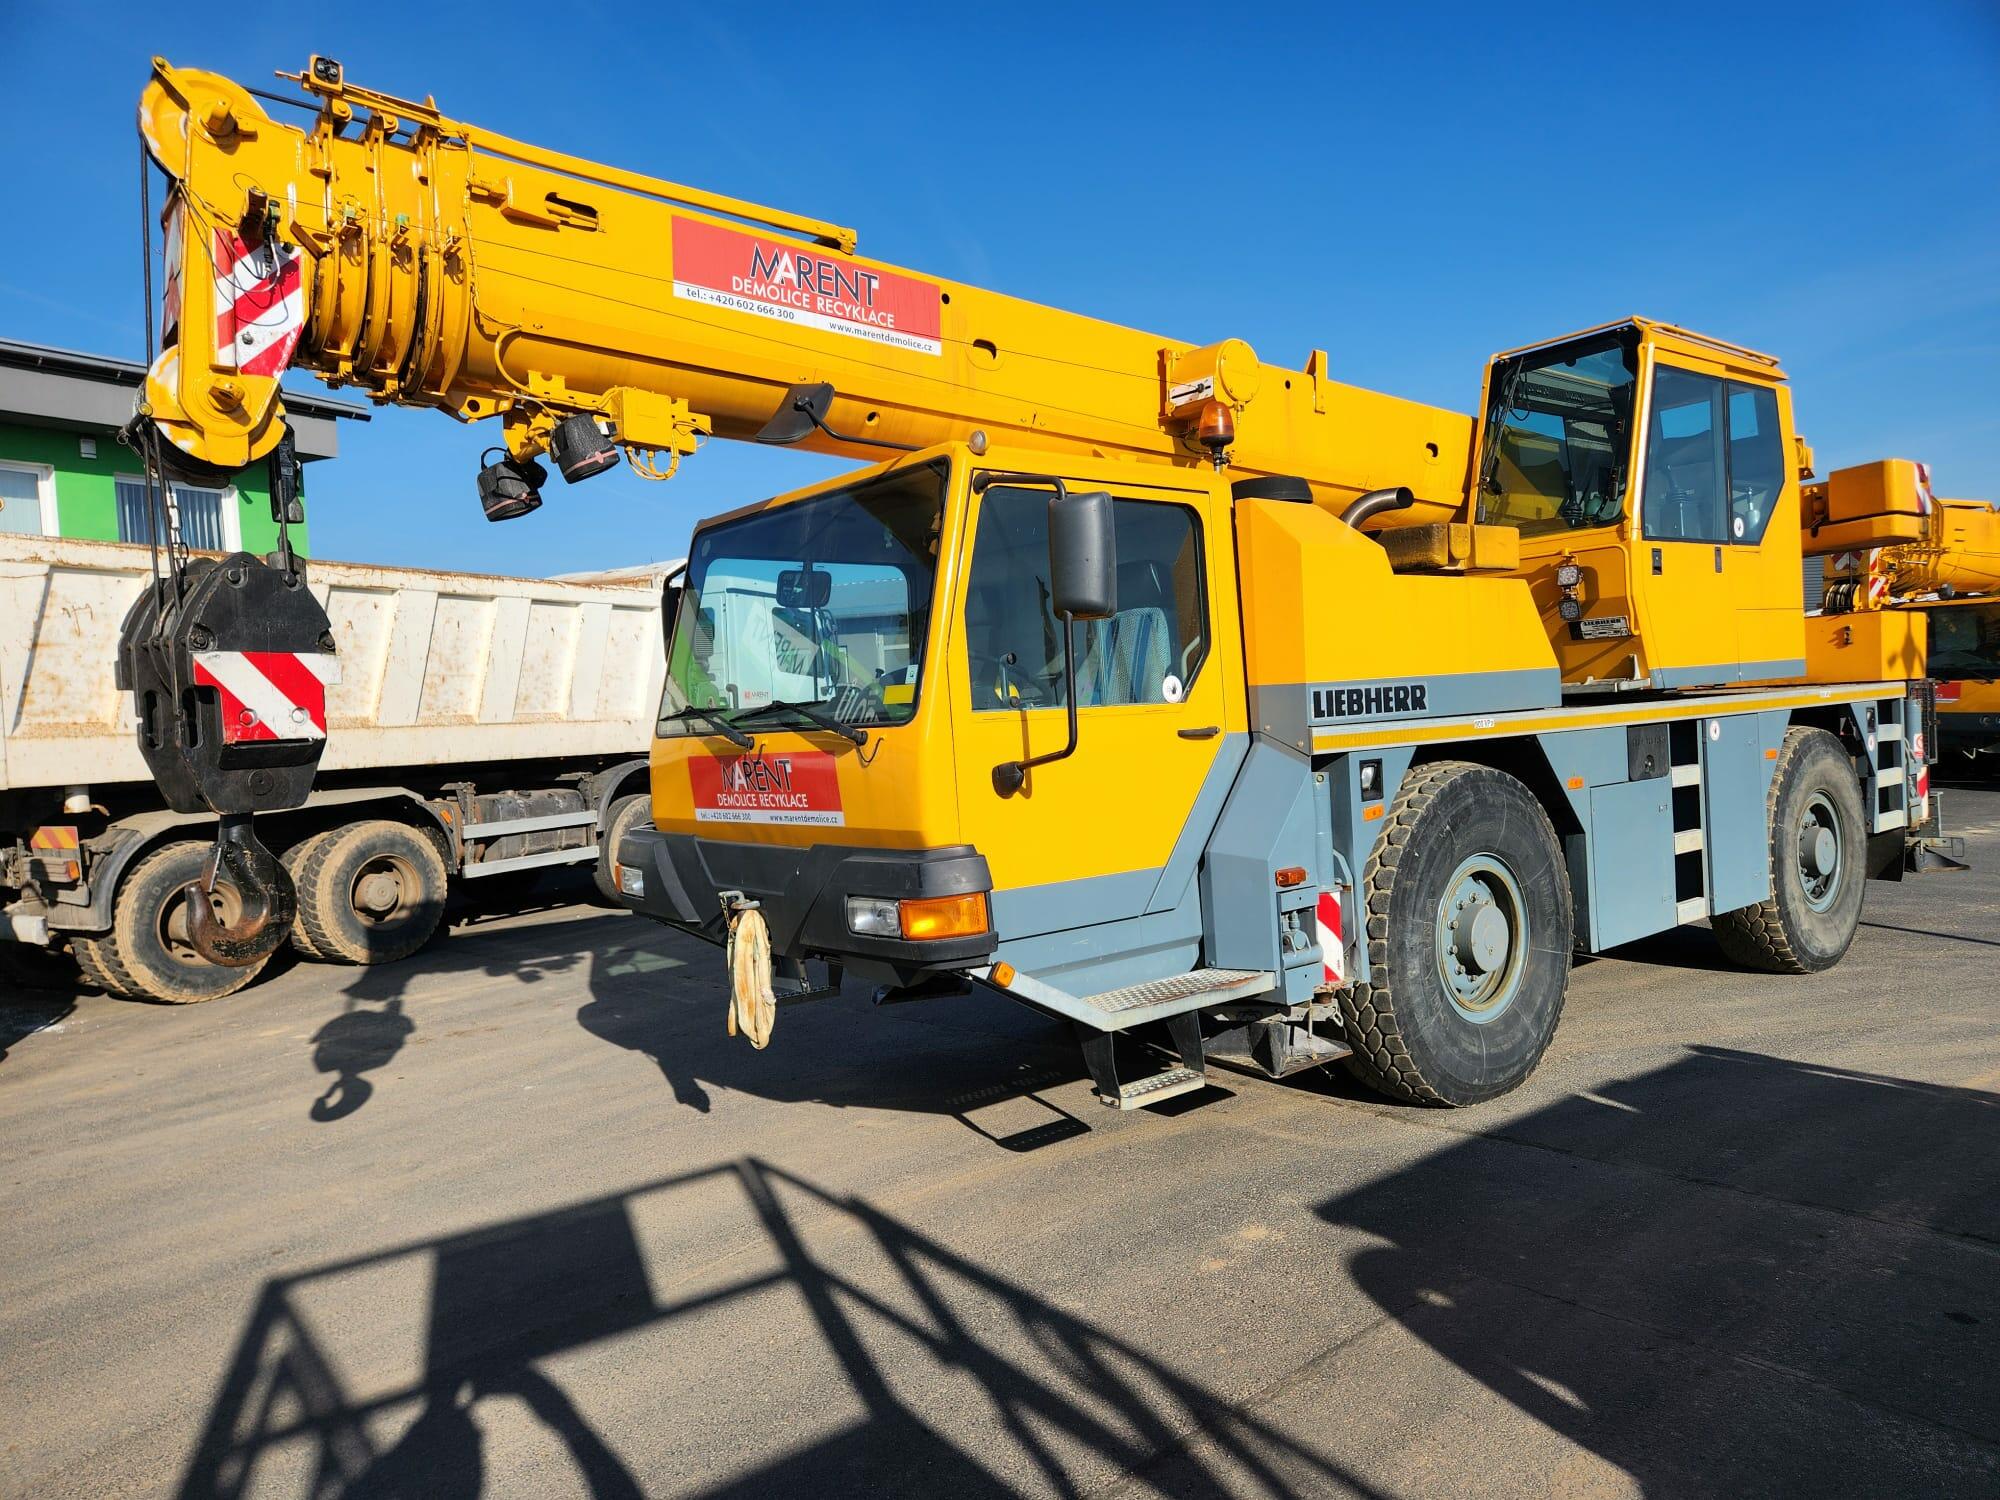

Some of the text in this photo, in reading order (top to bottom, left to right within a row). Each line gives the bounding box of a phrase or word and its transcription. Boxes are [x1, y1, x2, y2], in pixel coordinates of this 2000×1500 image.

[749, 241, 879, 307] MARENT
[686, 286, 933, 352] tel.: +420 602 666 300 www.marentdemolice.cz
[731, 275, 895, 328] DEMOLICE RECYKLACE
[1312, 684, 1427, 719] LIEBHERR
[721, 758, 792, 792] MARENT
[717, 793, 809, 808] DEMOLICE RECYKLACE
[769, 814, 838, 824] www.marentdemolice.cz
